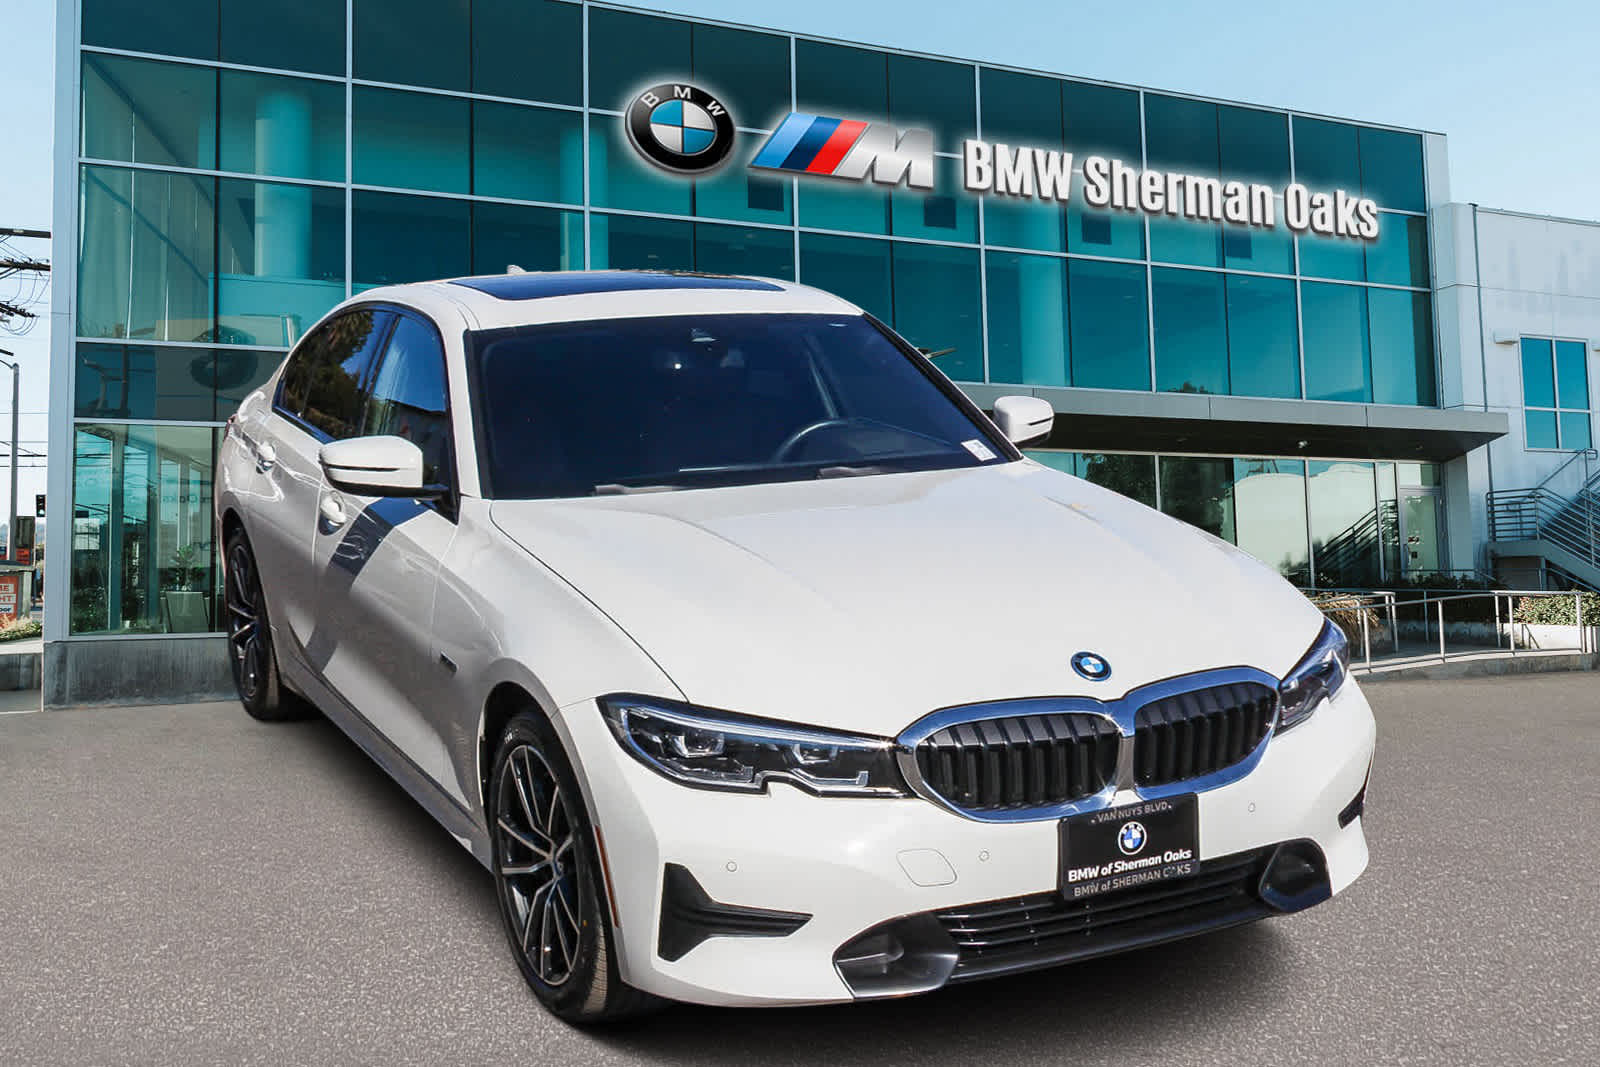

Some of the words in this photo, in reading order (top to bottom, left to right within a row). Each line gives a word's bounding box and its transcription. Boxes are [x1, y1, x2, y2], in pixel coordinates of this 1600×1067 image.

[641, 85, 725, 117] BMW
[963, 139, 1073, 201] BMW
[1083, 155, 1275, 228] Sherman
[1285, 183, 1379, 241] Oaks
[1097, 812, 1117, 822] VAN
[1118, 806, 1142, 819] NUYS
[1068, 866, 1099, 882] BMW
[1101, 863, 1114, 875] of
[1114, 855, 1161, 873] Sherman
[1163, 849, 1193, 862] Oaks
[1074, 881, 1099, 897] BMW
[1101, 880, 1112, 891] of
[1112, 871, 1161, 888] SHERMAN
